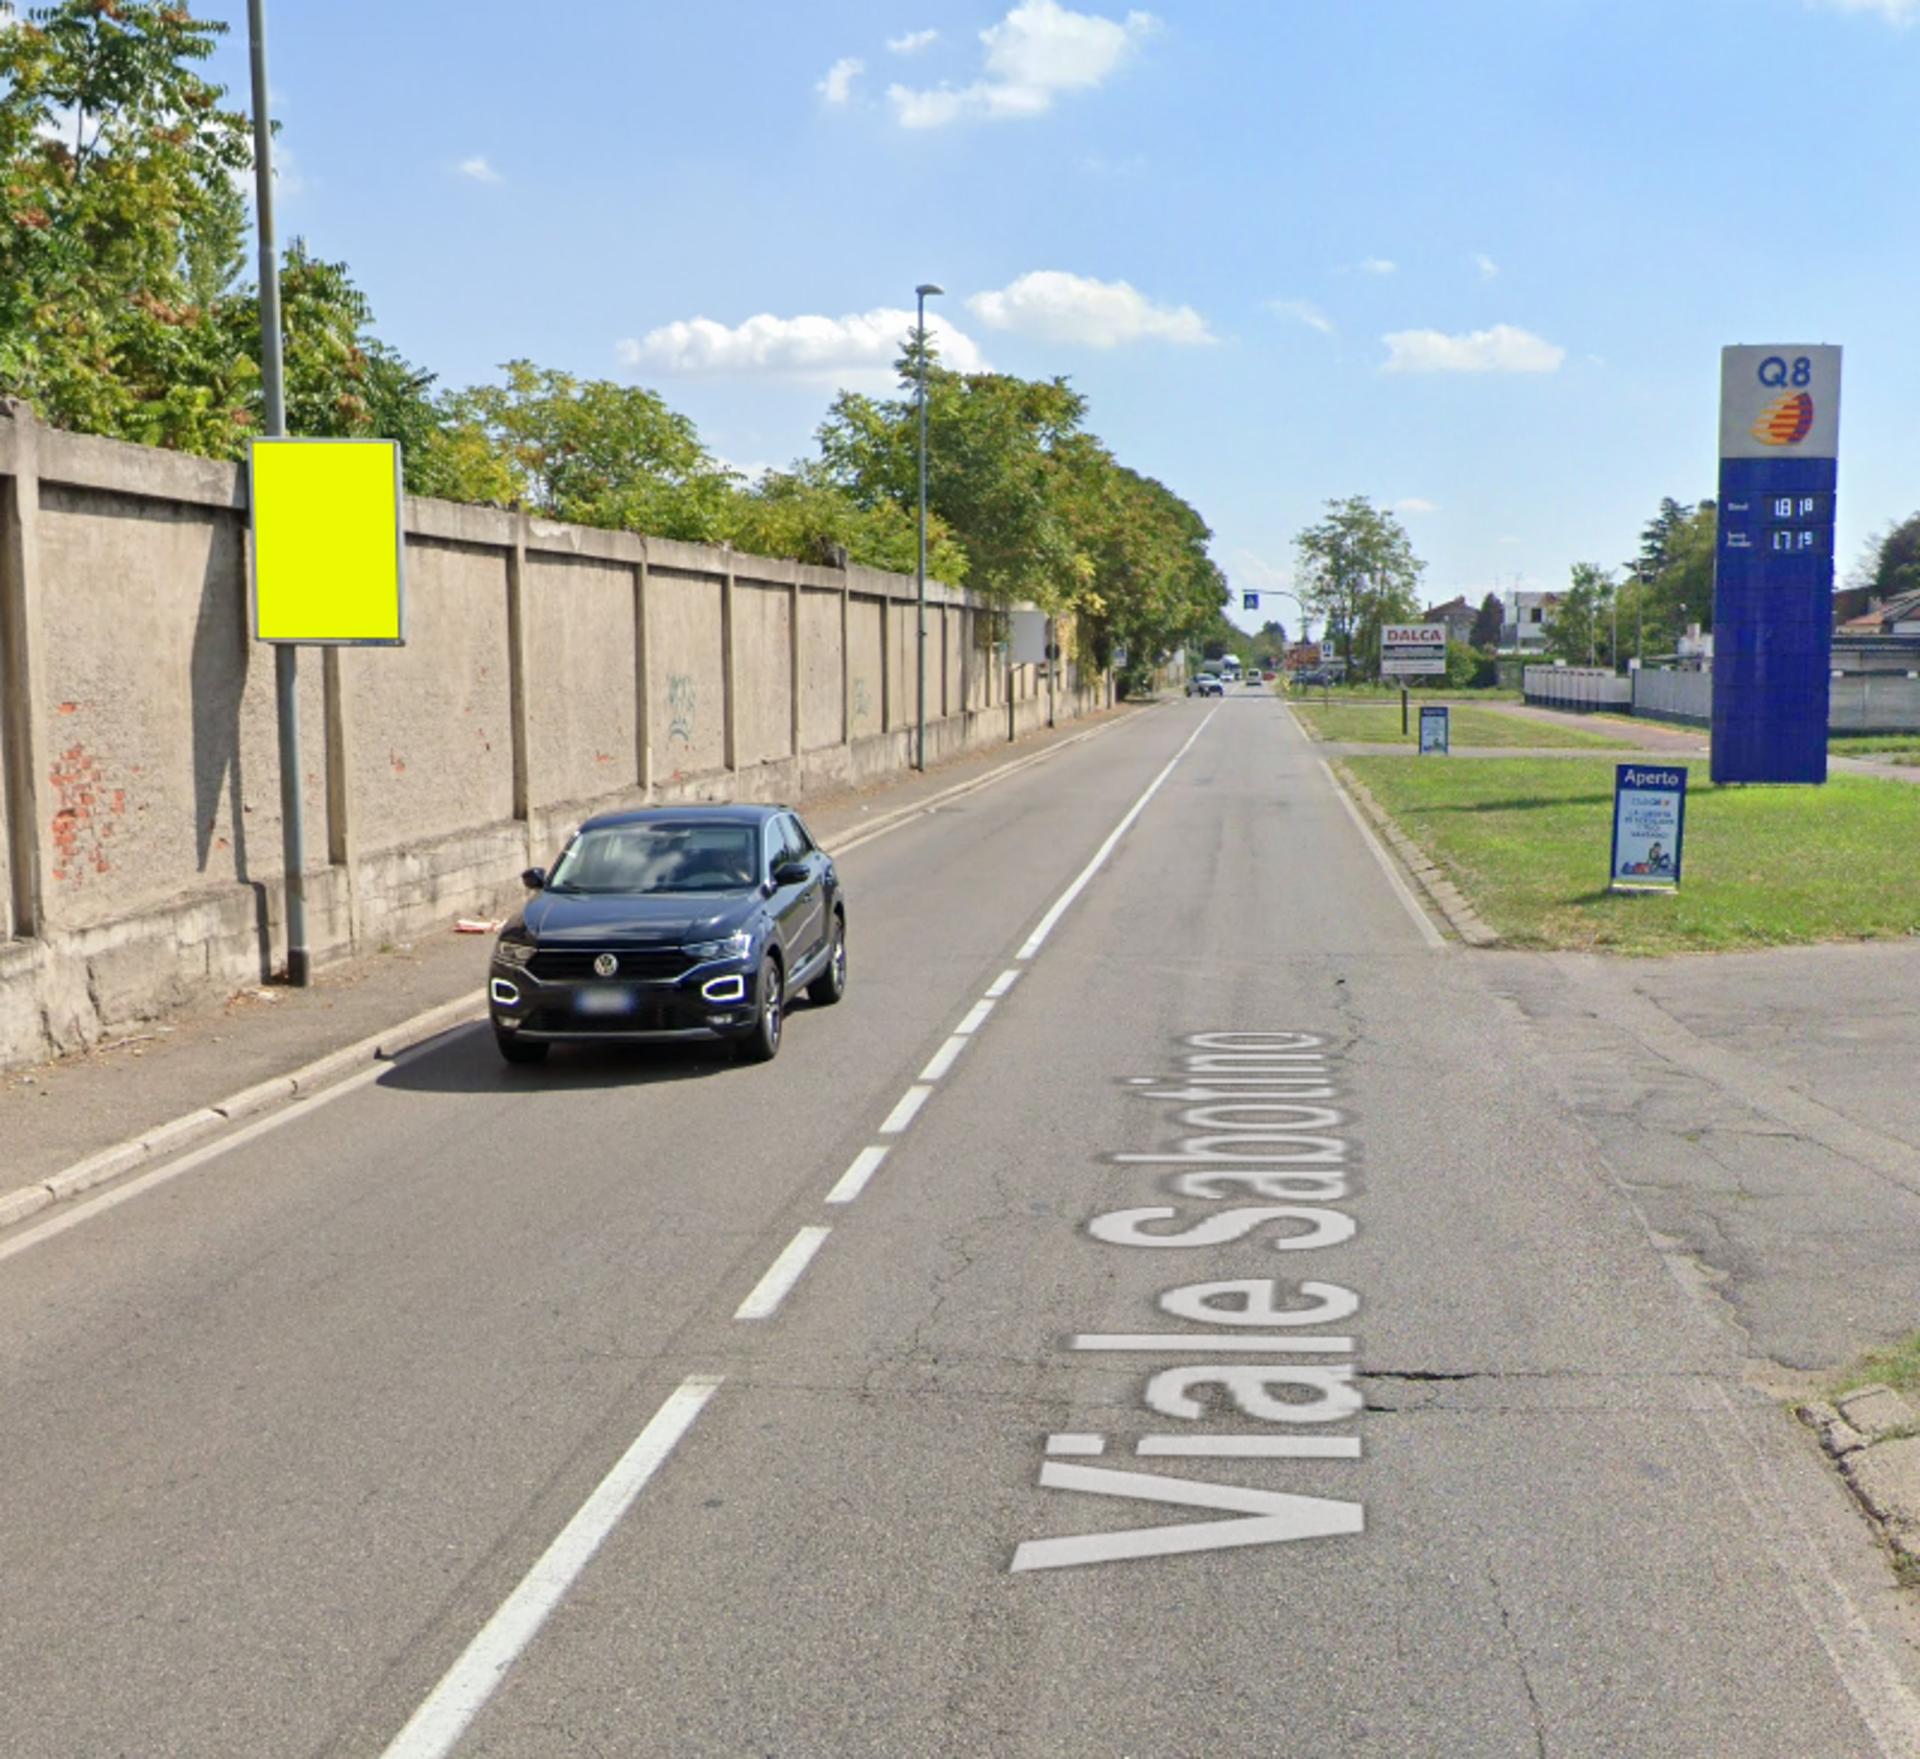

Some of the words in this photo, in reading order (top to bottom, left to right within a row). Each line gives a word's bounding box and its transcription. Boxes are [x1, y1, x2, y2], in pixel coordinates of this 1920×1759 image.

[1757, 356, 1811, 388] Q8
[1387, 630, 1441, 641] DALCA
[1624, 769, 1679, 786] Aperto
